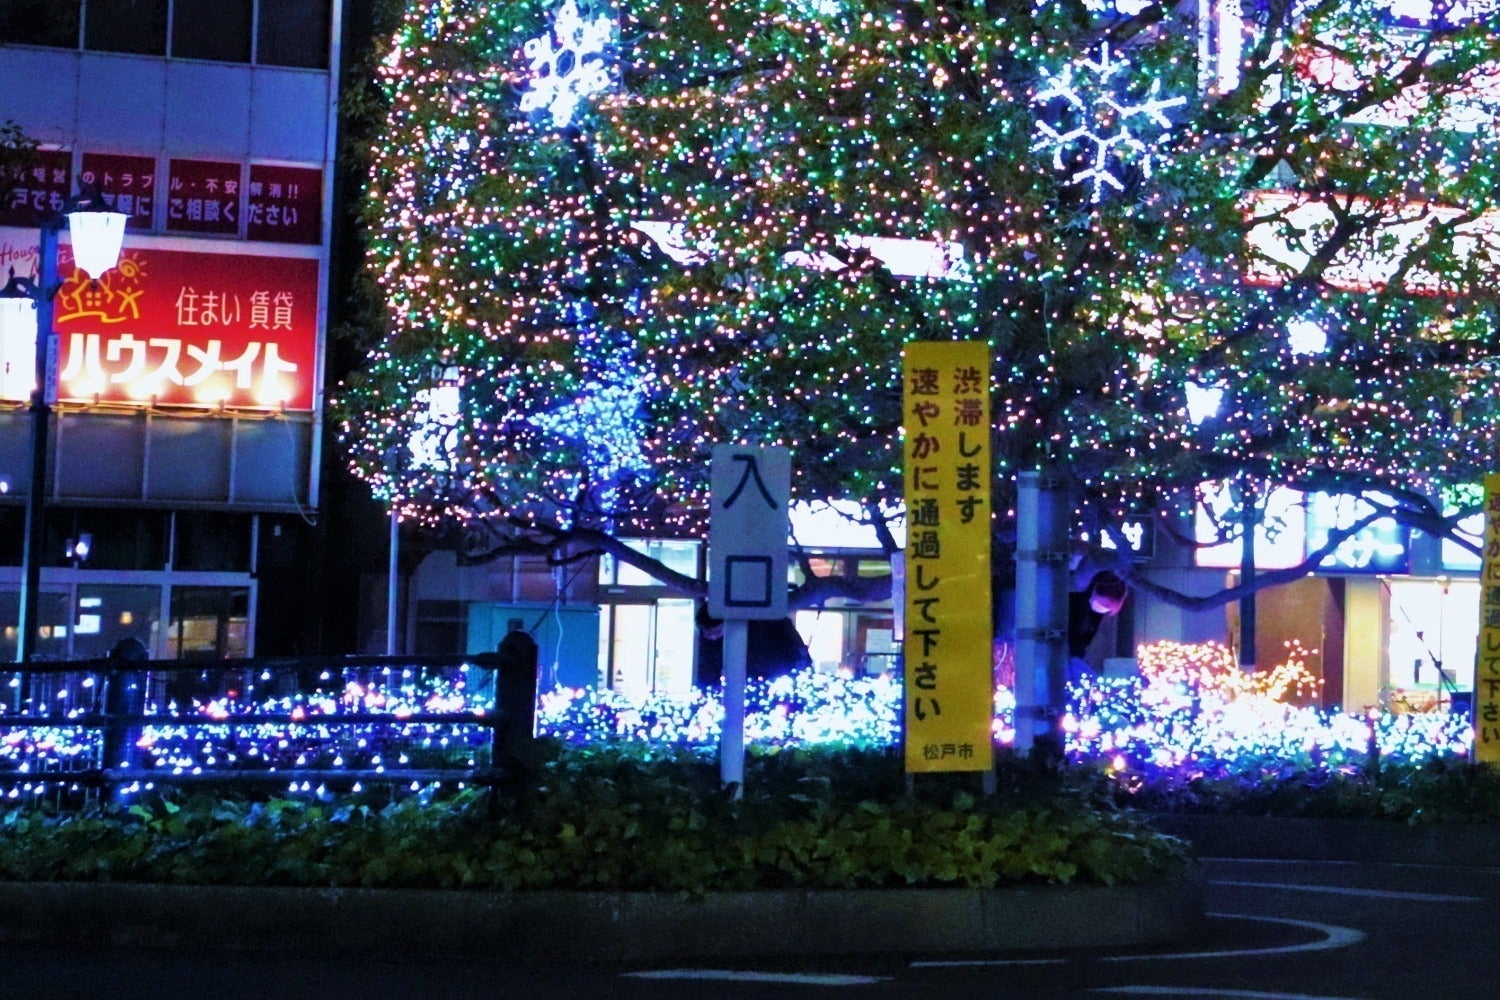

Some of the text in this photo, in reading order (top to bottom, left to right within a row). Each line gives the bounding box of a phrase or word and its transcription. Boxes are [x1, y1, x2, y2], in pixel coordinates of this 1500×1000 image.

[60, 333, 298, 388] ハウスメイト
[175, 286, 294, 331] 住まい 賃貸
[953, 366, 984, 525] 渋滞します
[722, 454, 778, 607] 入口
[910, 367, 942, 722] 速やかに通過して下さい
[923, 743, 974, 760] 松戸市
